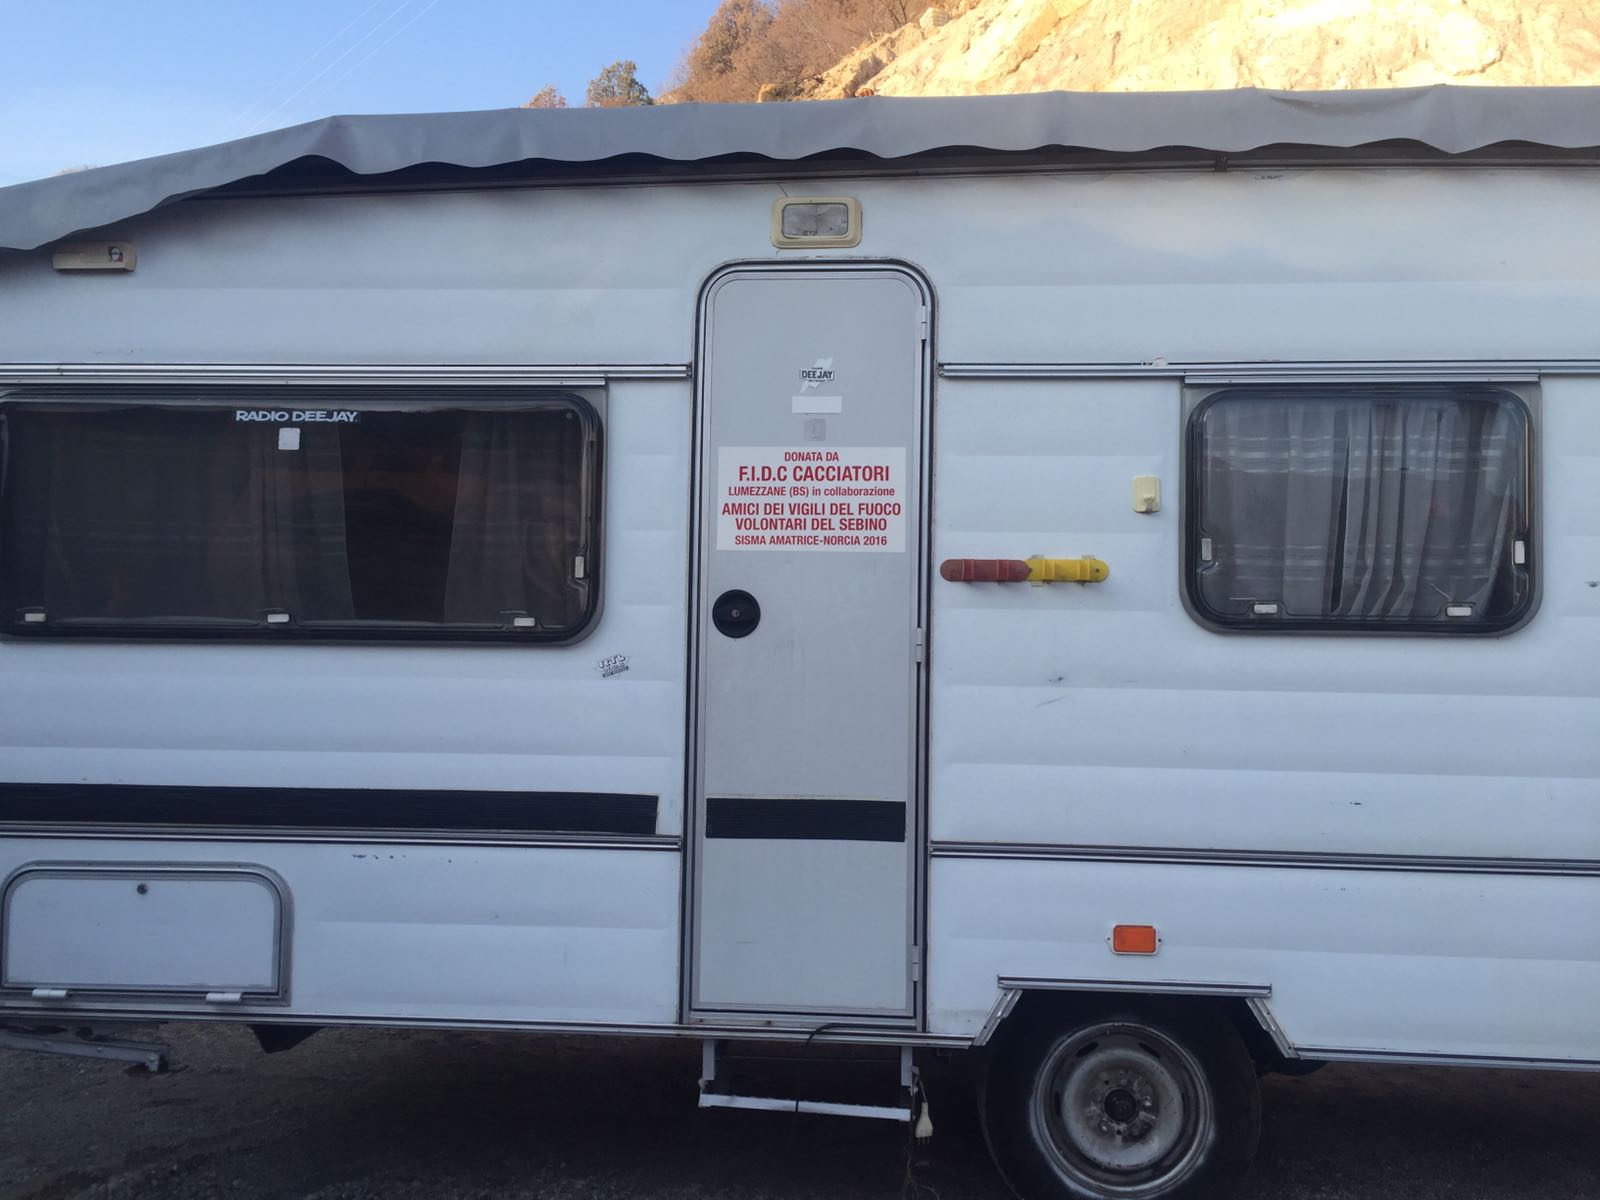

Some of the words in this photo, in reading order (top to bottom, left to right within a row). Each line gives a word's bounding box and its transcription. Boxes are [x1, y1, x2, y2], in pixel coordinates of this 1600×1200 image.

[801, 370, 833, 379] DEEJAY
[235, 410, 289, 421] RADIO
[784, 452, 823, 462] DONATA
[826, 452, 839, 462] DA
[739, 466, 787, 481] F.I.D.C
[792, 466, 890, 482] CACCIATORI
[728, 486, 786, 496] LUMEZZANE
[789, 486, 809, 498] (BS)
[812, 487, 821, 496] in
[824, 487, 895, 496] collaborazione
[722, 503, 759, 515] AMICI
[764, 503, 784, 515] DEI
[788, 503, 825, 515] VIGILI
[830, 503, 853, 515] DEL
[858, 503, 901, 515] FUOCO
[735, 518, 807, 531] VOLONTARI
[811, 518, 835, 531] DEL
[839, 518, 887, 531] SEBINO
[735, 535, 766, 545] SISMA
[769, 535, 860, 546] AMATRICE-NORCIA
[863, 535, 887, 546] 2016
